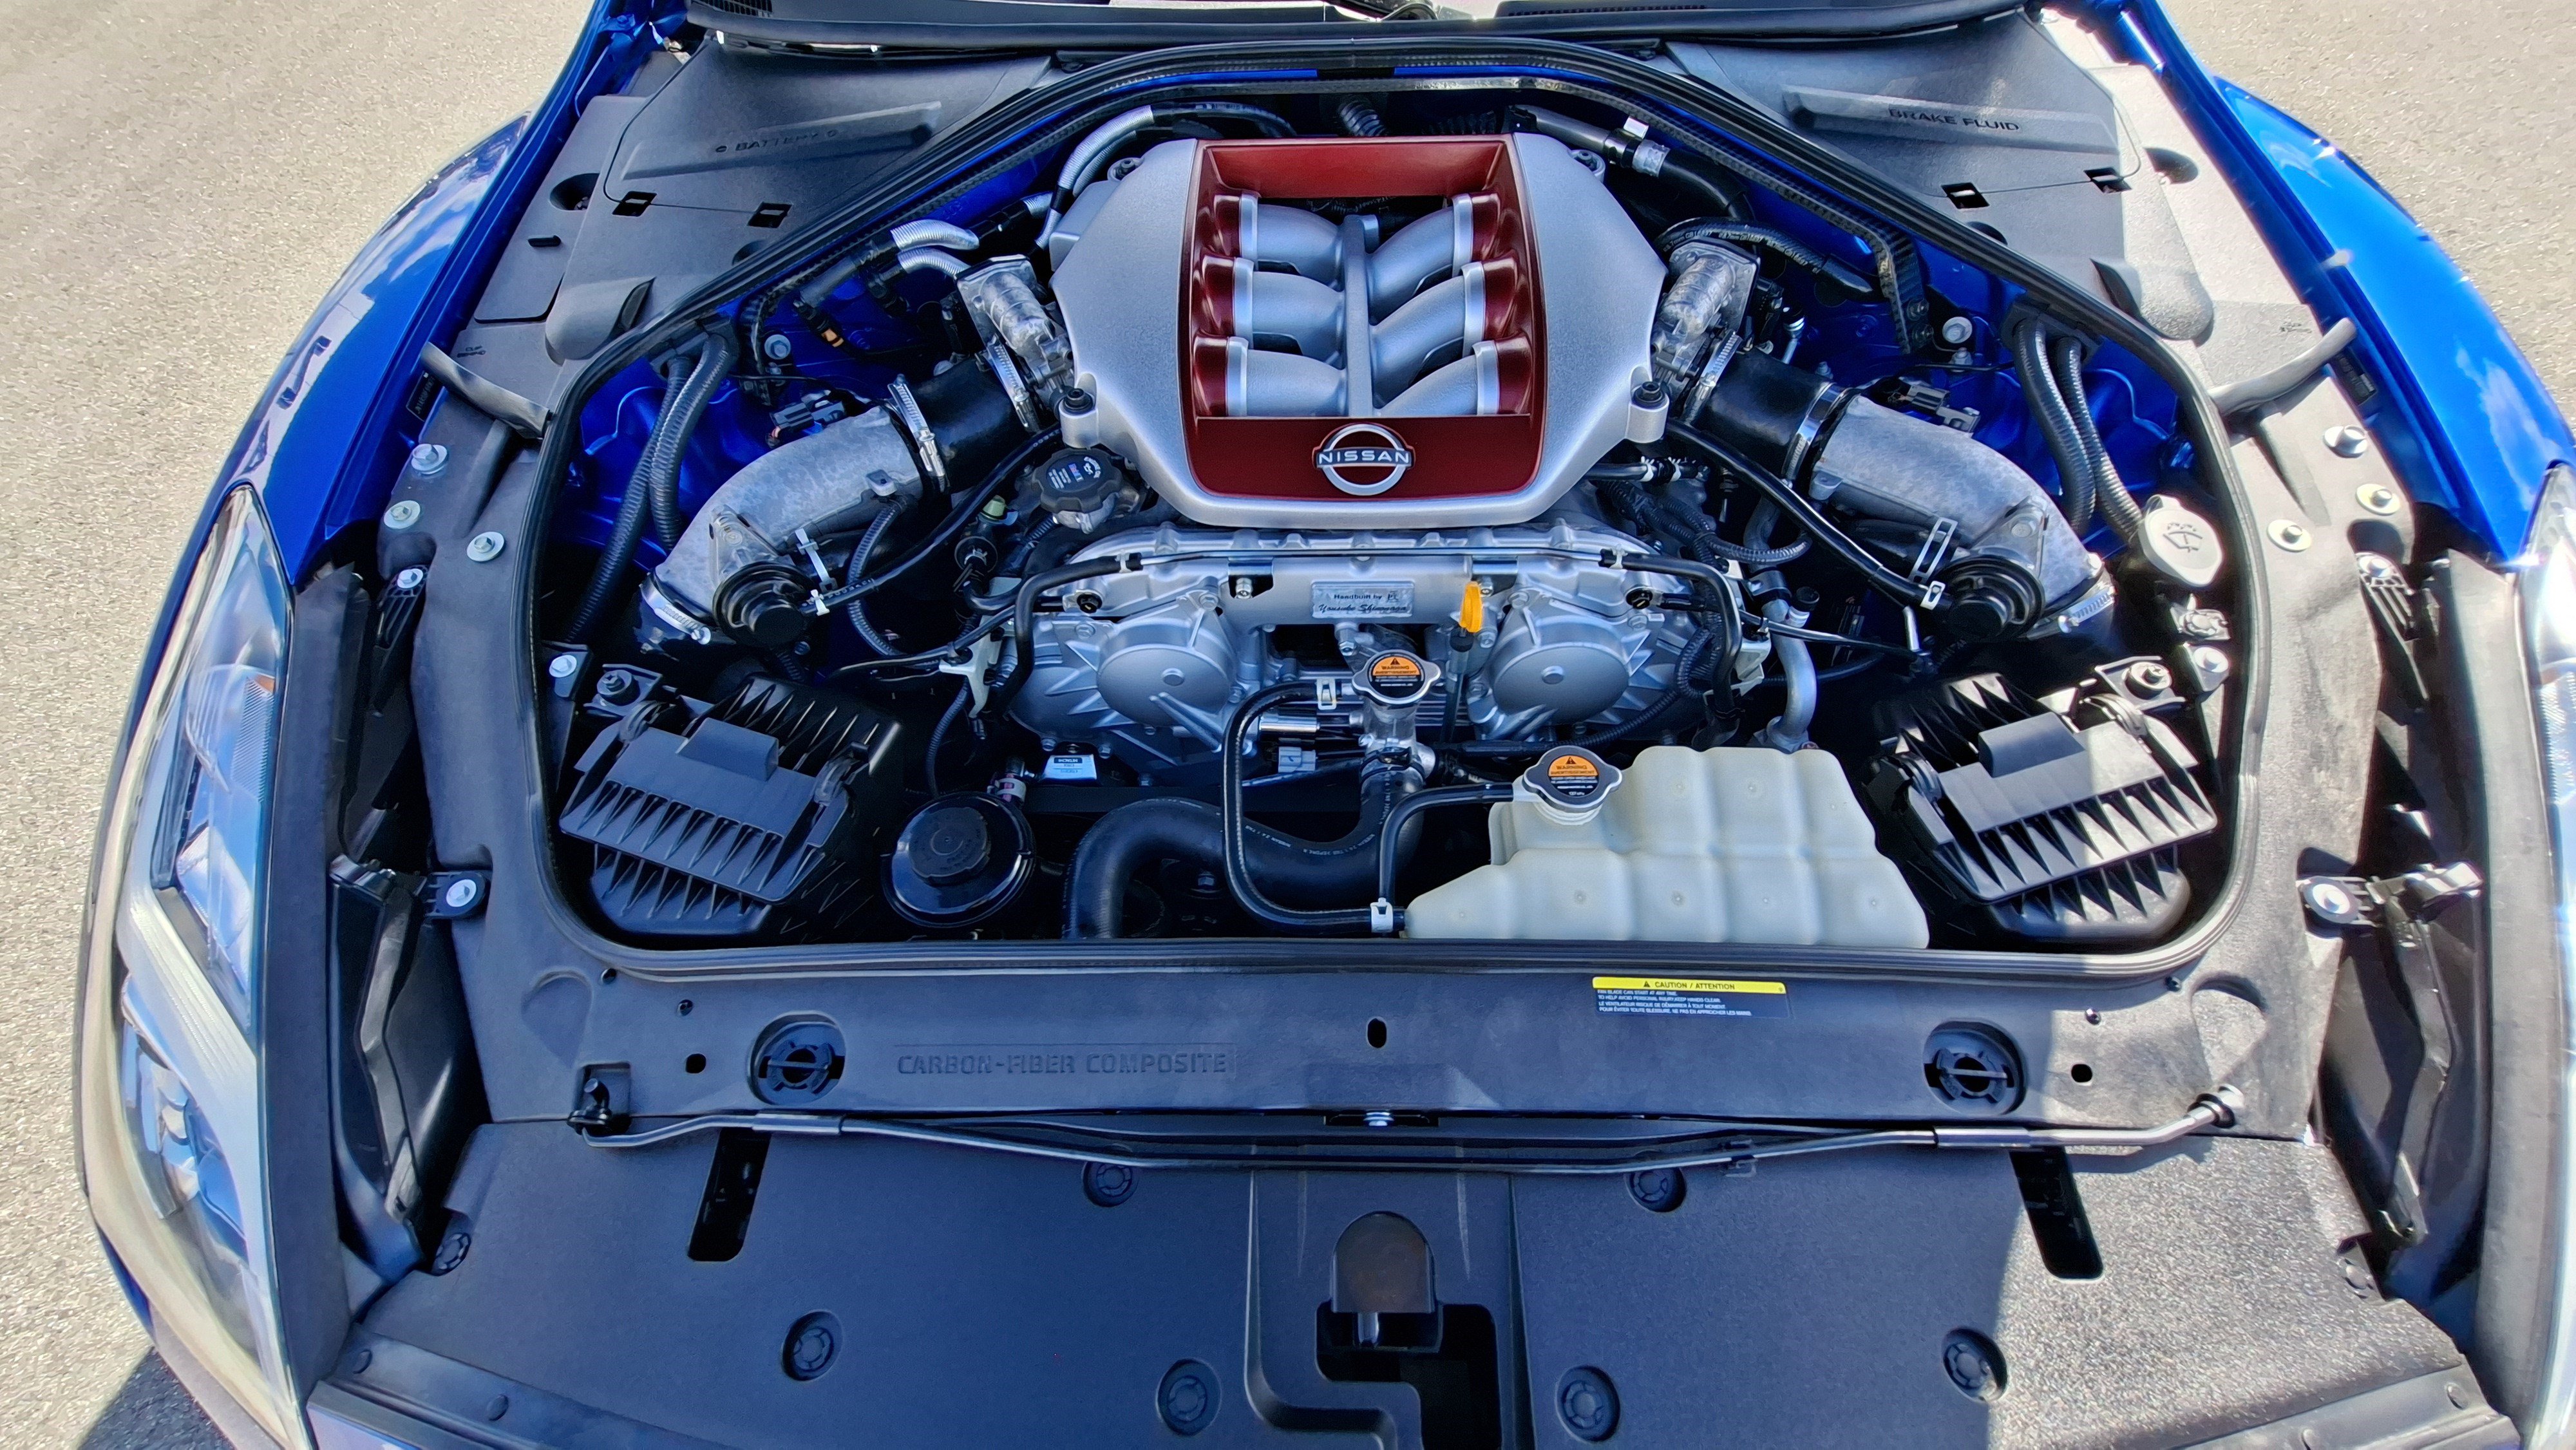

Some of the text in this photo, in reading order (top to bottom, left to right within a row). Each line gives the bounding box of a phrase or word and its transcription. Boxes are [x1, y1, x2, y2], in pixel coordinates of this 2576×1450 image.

[1888, 108, 2020, 131] BRAKE FLUID
[735, 133, 819, 151] BATTERY
[1318, 450, 1409, 464] NISSAN
[897, 1052, 1226, 1075] CARBON-FIBER COMPOSITE
